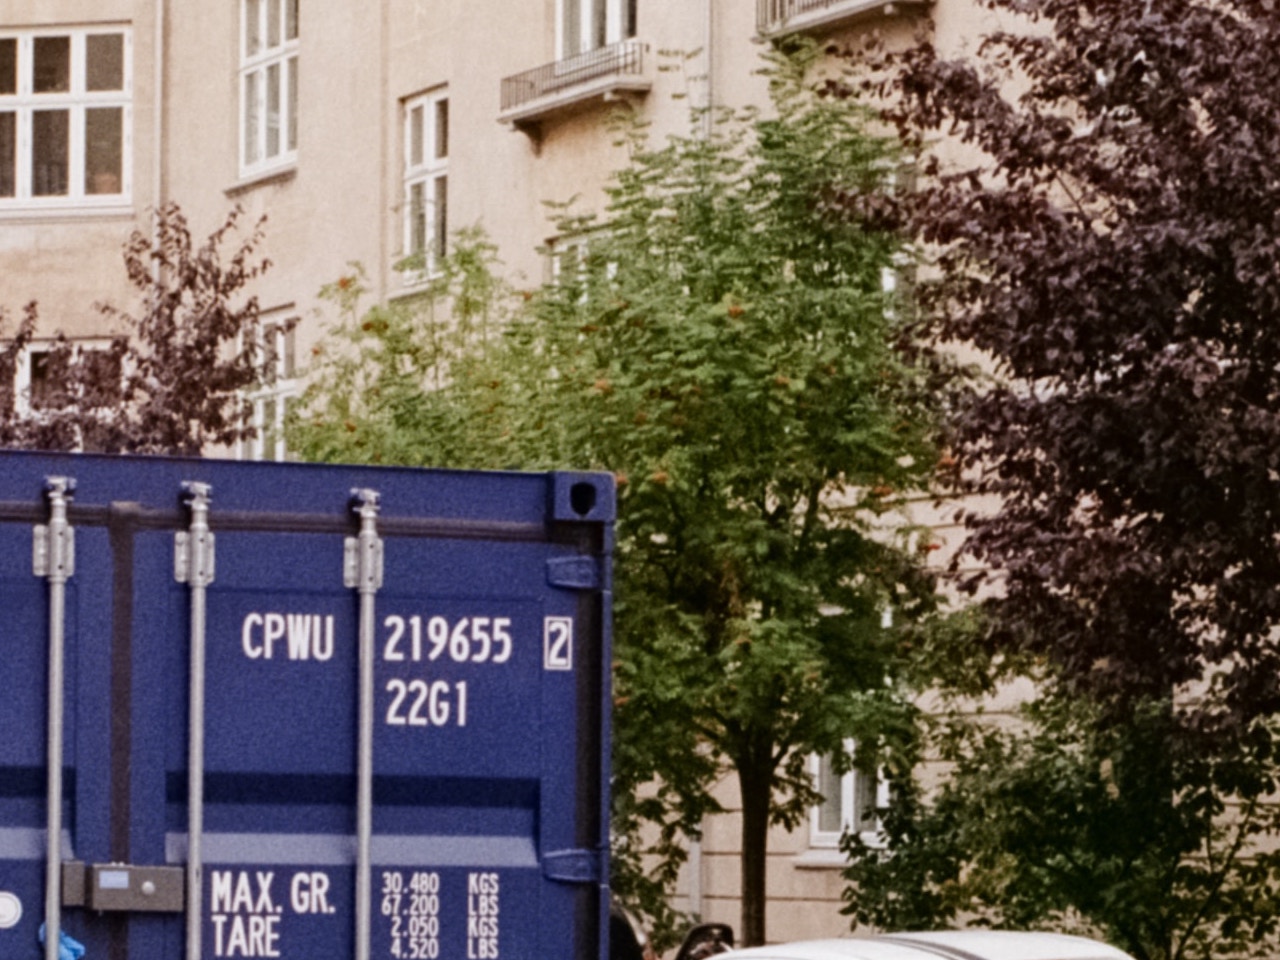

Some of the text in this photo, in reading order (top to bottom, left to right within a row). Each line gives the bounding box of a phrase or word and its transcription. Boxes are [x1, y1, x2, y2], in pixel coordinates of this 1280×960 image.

[242, 613, 569, 666] CPWU 219655 2
[386, 679, 467, 726] 22G1
[211, 871, 336, 914] MAX. GR.
[382, 872, 499, 894] 30.480 KGS
[381, 895, 499, 916] 67.200 LBS
[211, 915, 280, 957] TARE
[390, 916, 499, 937] 2.050 KGS
[390, 938, 499, 959] 4.520 LBS
